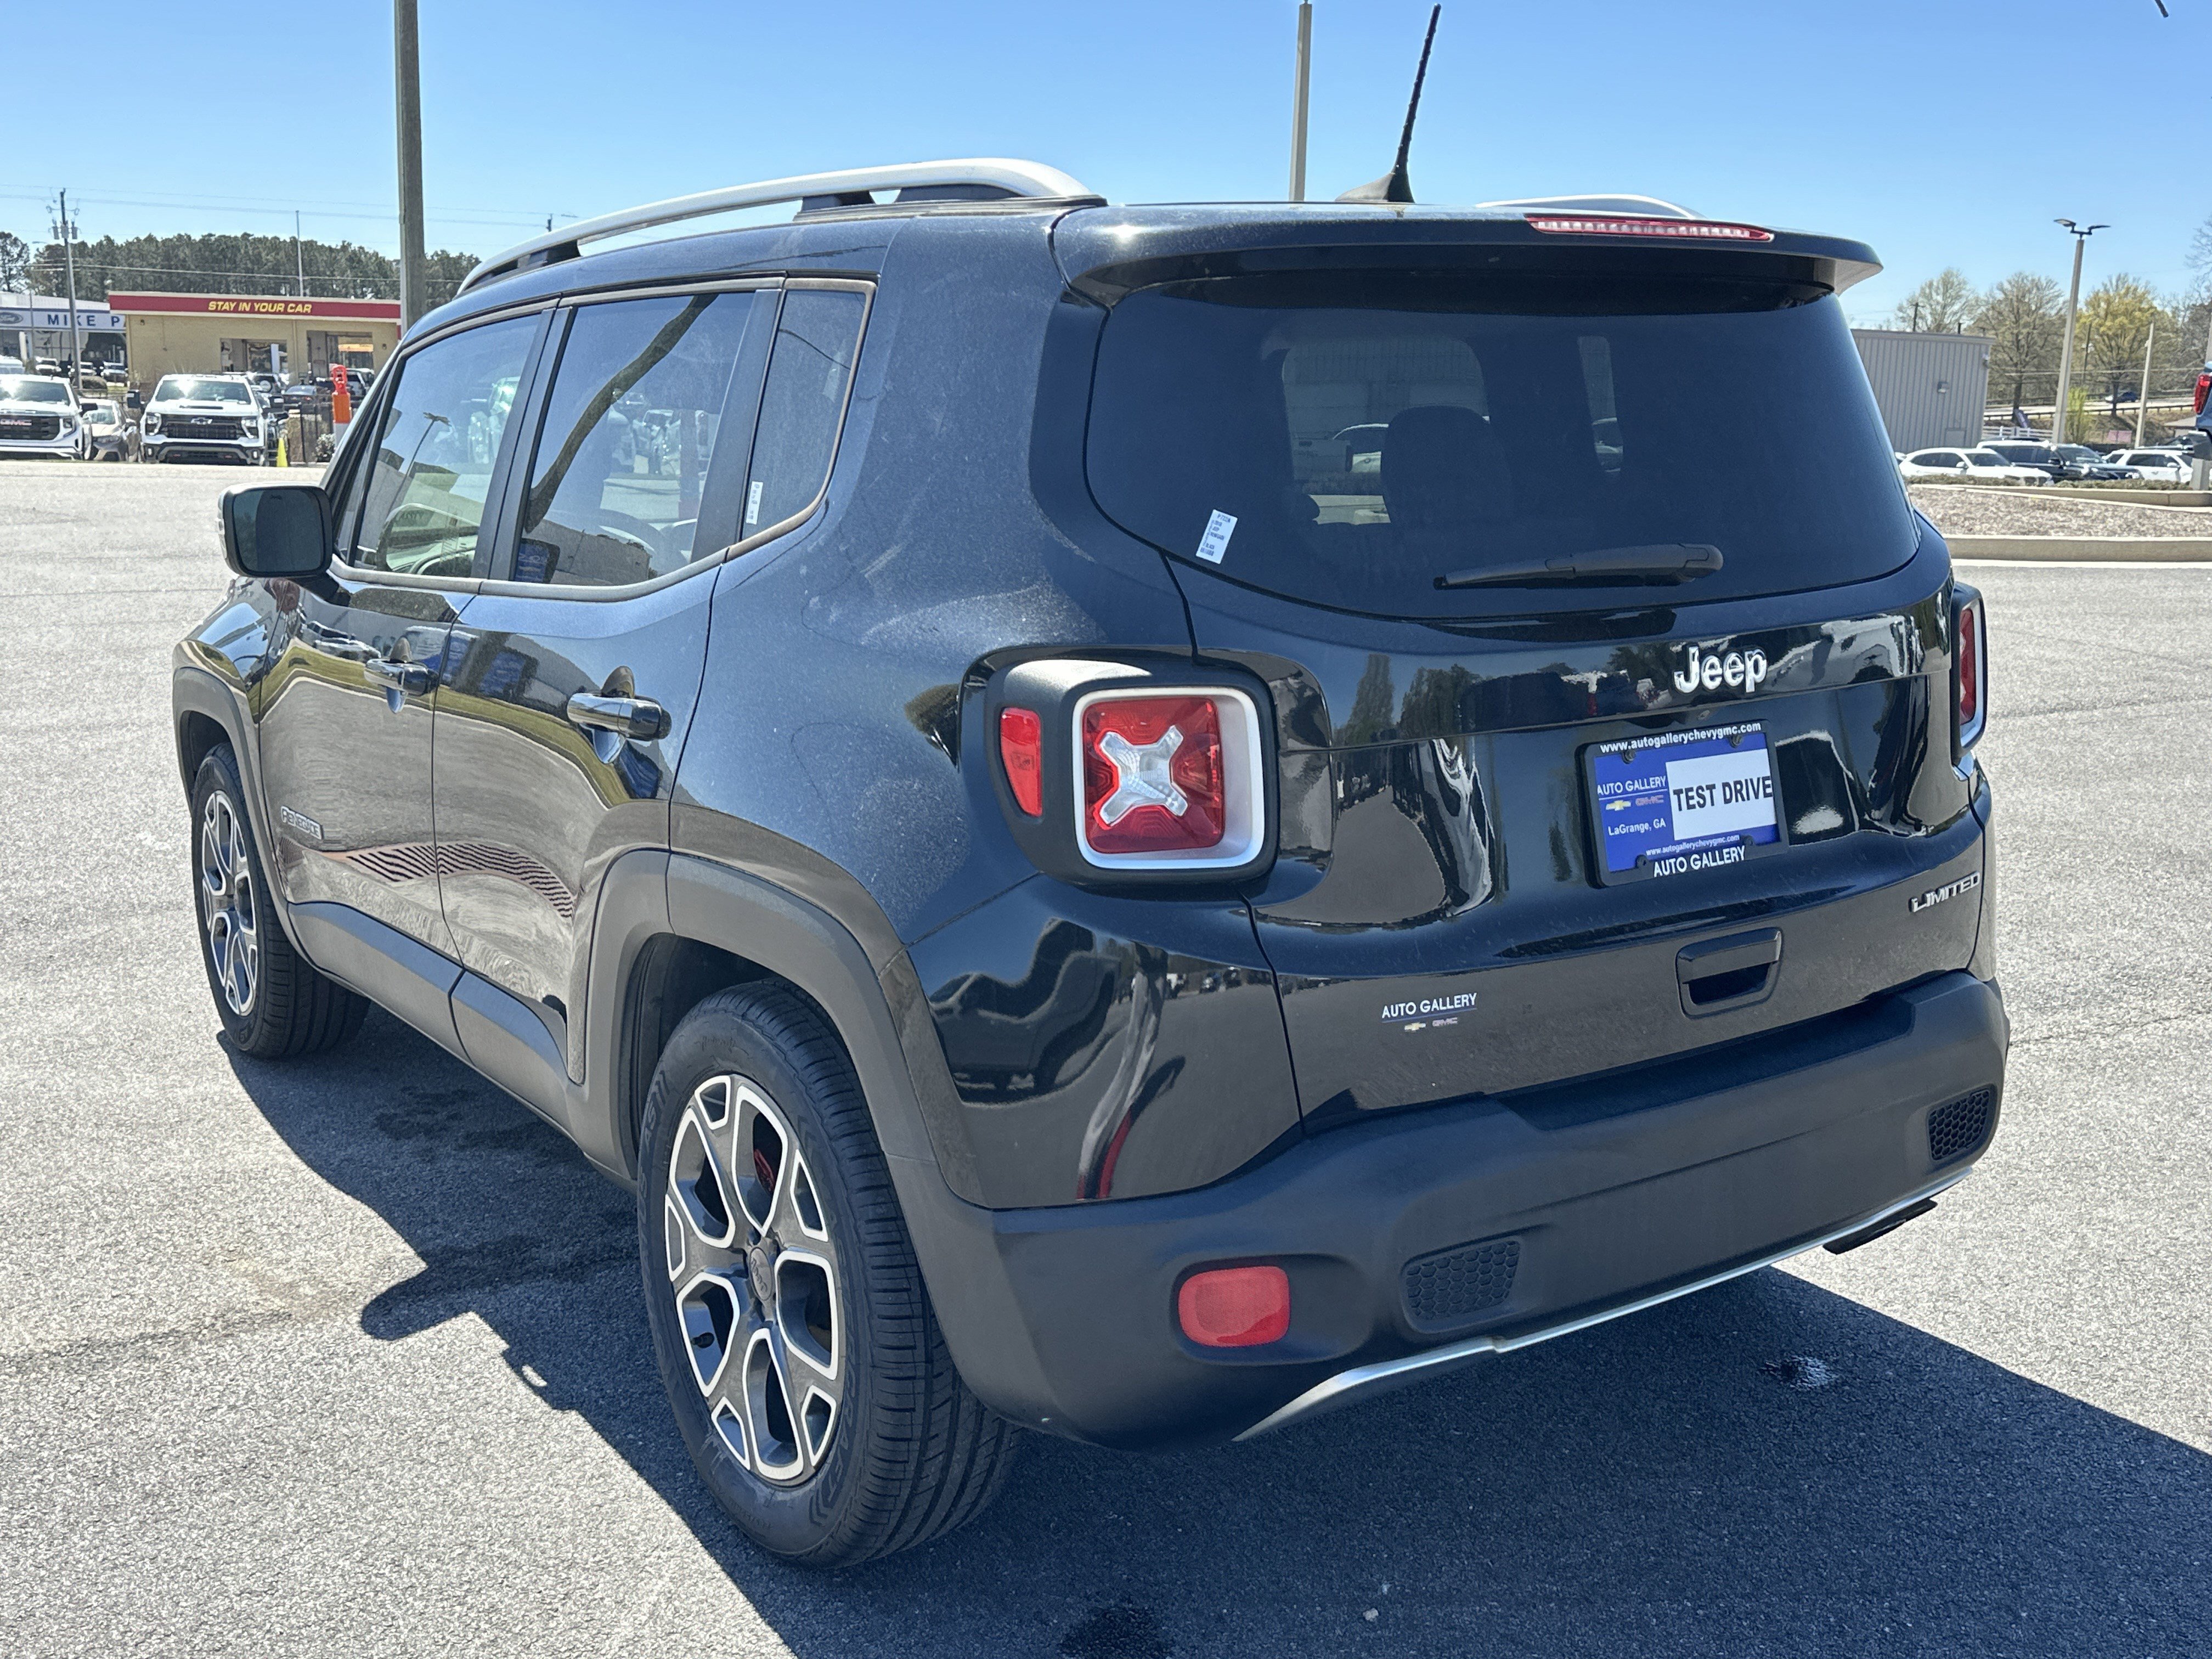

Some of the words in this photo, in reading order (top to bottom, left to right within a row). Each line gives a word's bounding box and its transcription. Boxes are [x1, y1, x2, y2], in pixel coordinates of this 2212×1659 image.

[208, 301, 237, 311] STAY
[238, 302, 251, 312] IN
[253, 303, 285, 313] YOUR
[287, 303, 312, 313] CAR
[1674, 646, 1767, 693] Jeep
[1600, 722, 1762, 753] www.autogallerychevygmc.com
[1597, 782, 1623, 795] AUTO
[1625, 775, 1666, 791] GALLERY
[1673, 783, 1716, 811] TEST
[1722, 776, 1773, 804] DRIVE
[1608, 823, 1652, 836] LaGrange,
[1653, 817, 1666, 828] GA
[1646, 834, 1740, 856] www.autogallerychevygmc.com
[1654, 856, 1687, 878] AUTO
[1690, 845, 1745, 870] GALLERY
[1911, 871, 1980, 913] LIMITED
[1381, 1002, 1417, 1019] AUTO
[1420, 992, 1477, 1013] GALLERY
[1432, 1017, 1458, 1028] GMC
